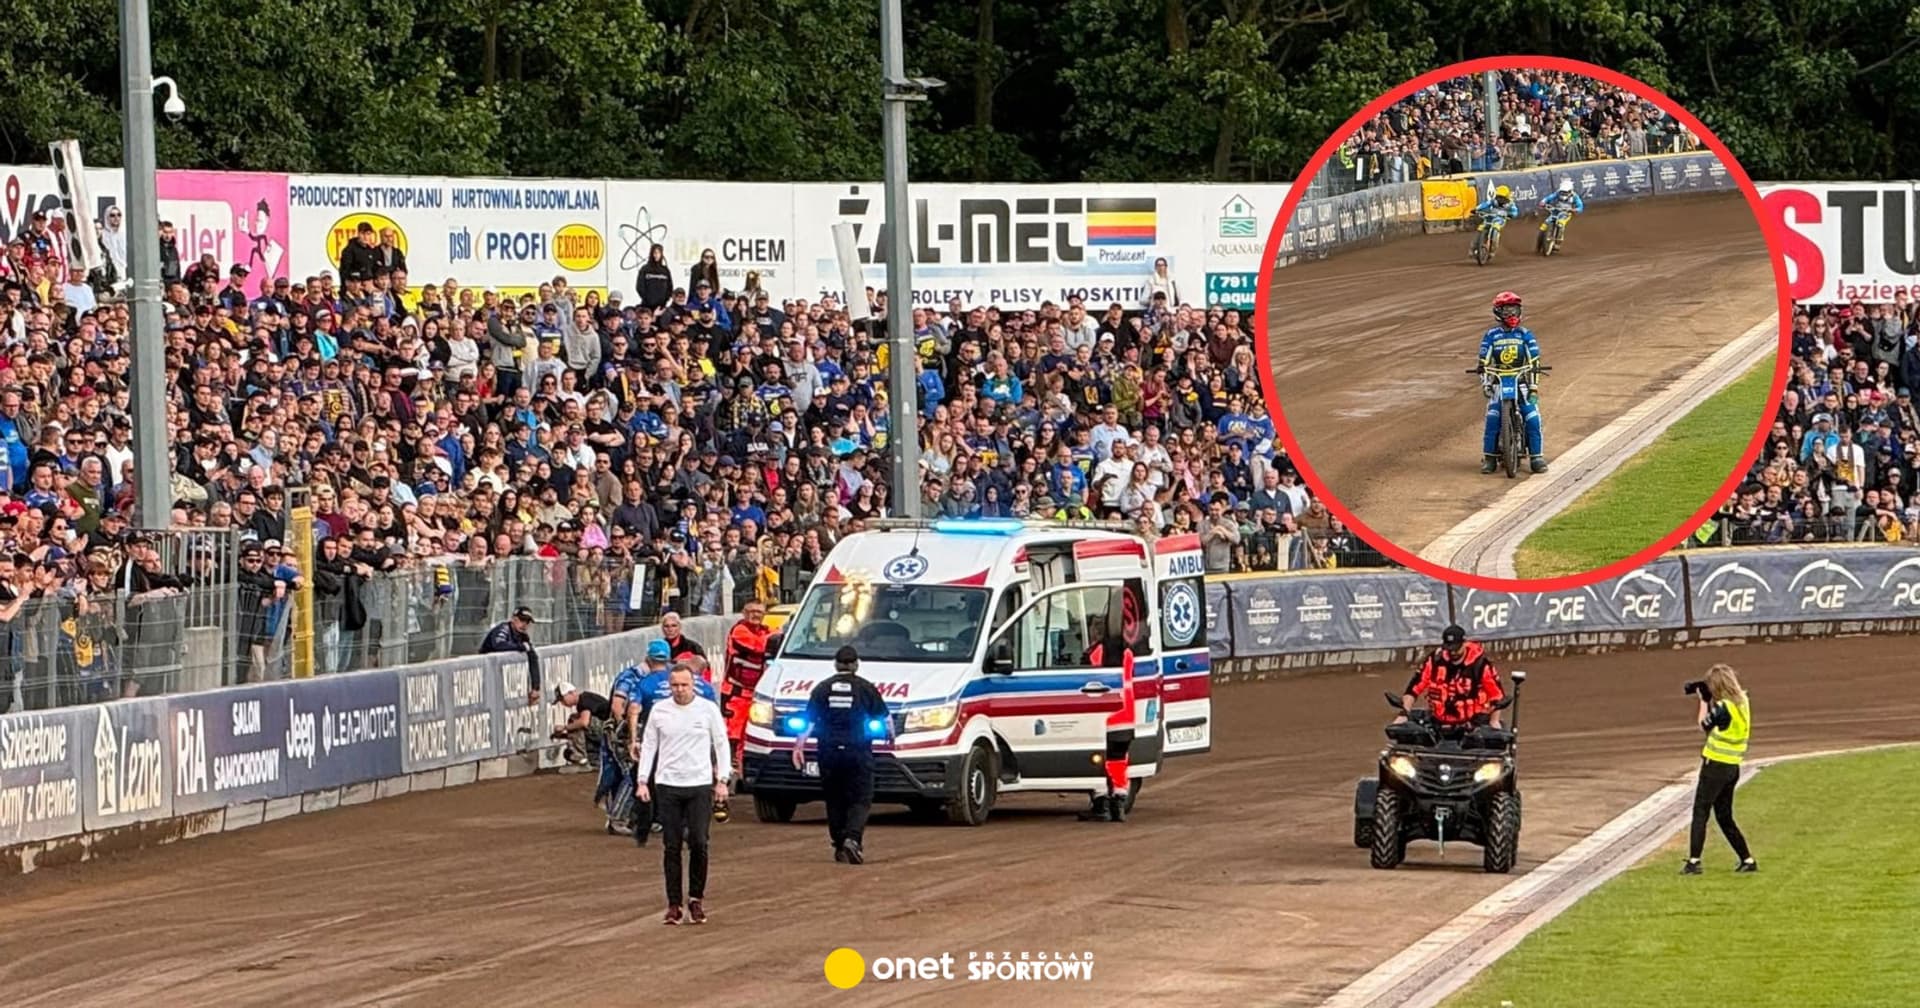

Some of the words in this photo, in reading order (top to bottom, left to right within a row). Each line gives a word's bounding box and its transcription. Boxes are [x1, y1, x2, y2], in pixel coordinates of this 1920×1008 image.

[289, 186, 363, 207] PRODUCENT
[365, 188, 443, 208] STYROPIANU
[452, 188, 523, 209] HURTOWNIA
[524, 189, 600, 210] BUDOWLANA
[449, 226, 471, 264] psb
[486, 232, 547, 260] PROFI
[556, 234, 600, 260] EKOBUD
[1099, 248, 1146, 263] Producent
[911, 289, 974, 304] ROLETY
[990, 288, 1042, 303] PLISY
[1546, 596, 1585, 623] PGE
[1622, 594, 1662, 619] PGE
[1712, 588, 1756, 614] PGE
[1801, 585, 1847, 610] PGE
[1473, 602, 1509, 630] PGE
[232, 700, 261, 736] SALON
[286, 698, 316, 769] Jeep
[177, 708, 207, 796] RiA
[214, 748, 280, 791] SAMOCHODOWY
[0, 775, 25, 838] omy
[27, 785, 34, 823] z
[35, 770, 76, 820] drewna
